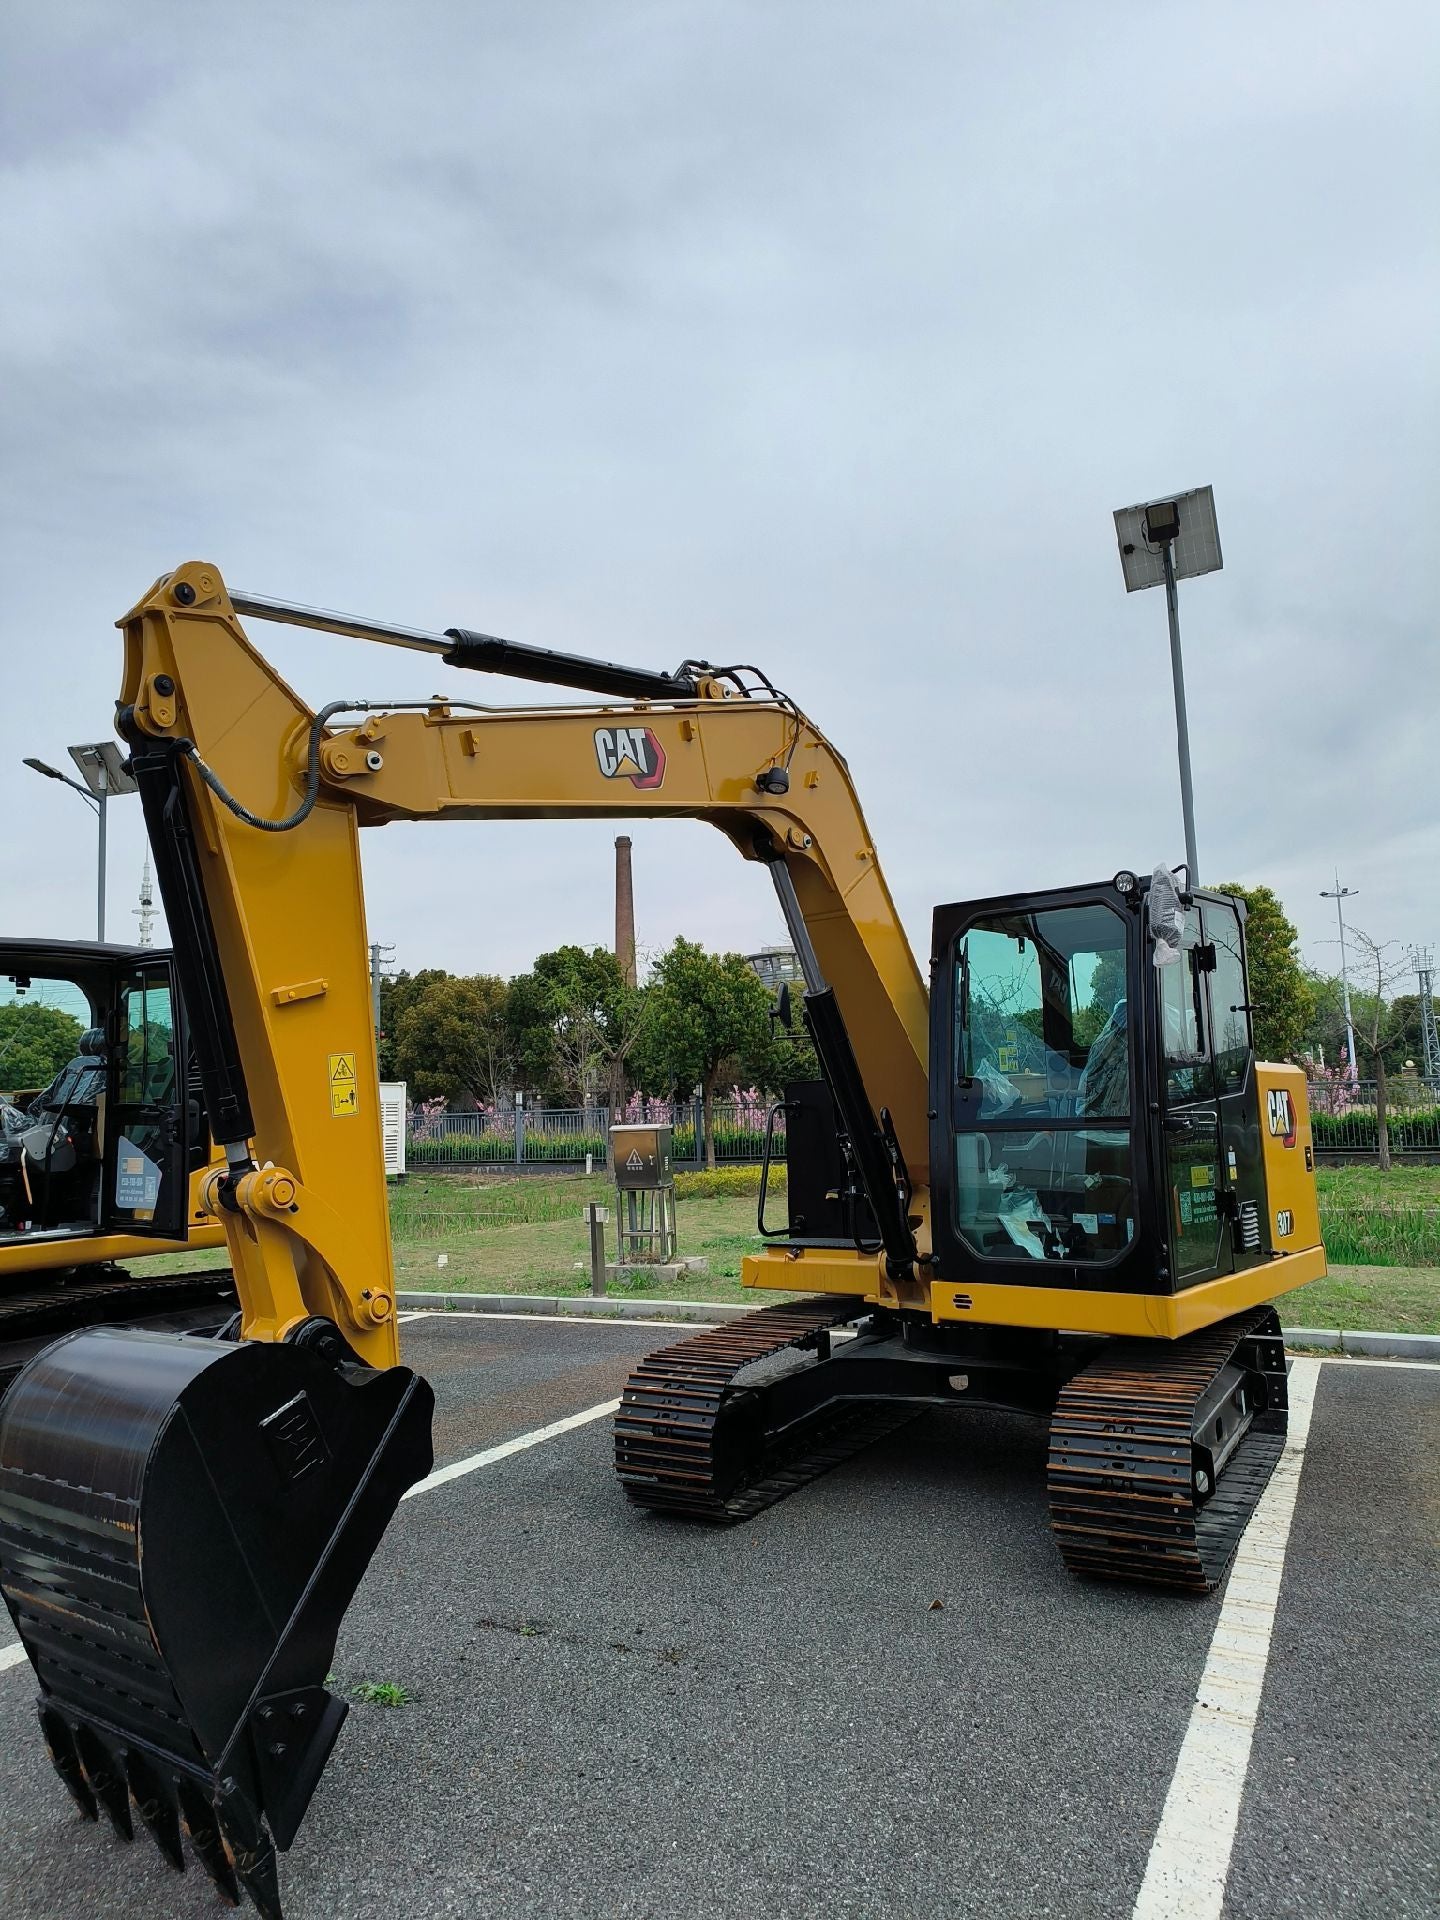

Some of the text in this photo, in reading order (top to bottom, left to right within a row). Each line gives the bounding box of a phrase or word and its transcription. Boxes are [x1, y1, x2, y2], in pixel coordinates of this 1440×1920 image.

[594, 728, 648, 777] CAT
[1267, 1090, 1290, 1135] CAT
[1277, 1210, 1290, 1236] 307
